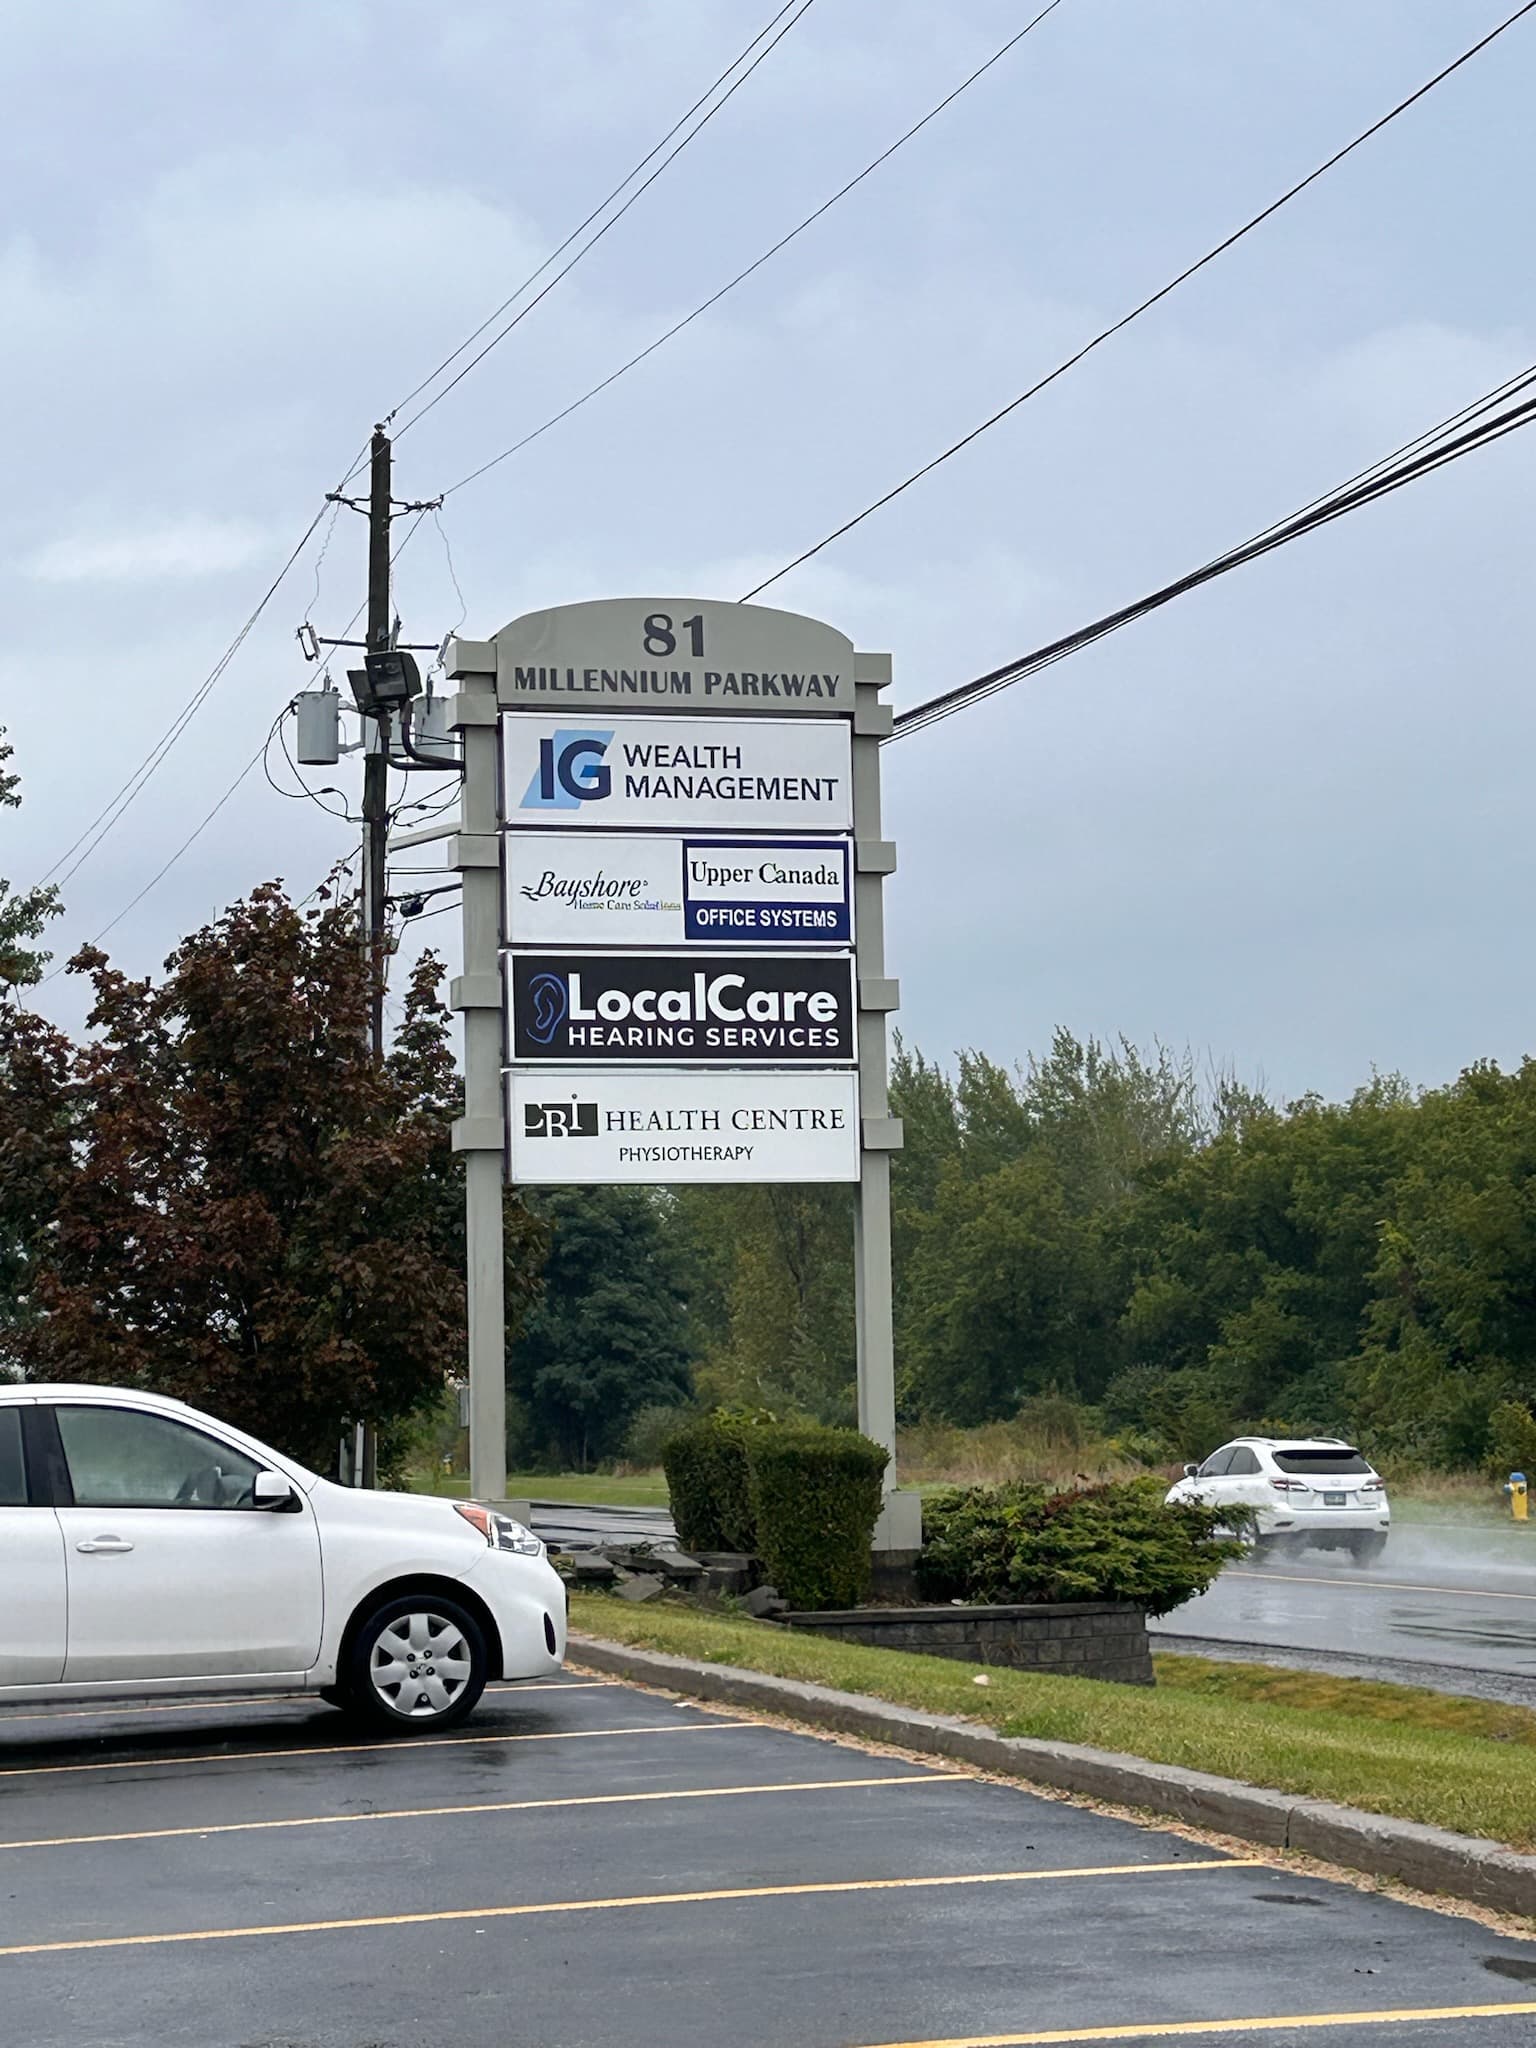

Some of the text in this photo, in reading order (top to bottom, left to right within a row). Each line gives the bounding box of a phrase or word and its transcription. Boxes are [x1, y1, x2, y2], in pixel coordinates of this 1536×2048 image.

[643, 613, 705, 658] 81
[514, 667, 840, 698] MILLENNIUM PARKWAY
[539, 738, 612, 801] IG
[623, 744, 742, 770] WEALTH
[625, 776, 839, 801] MANAGEMENT
[690, 861, 840, 887] Upper Canada
[696, 908, 838, 928] OFFICE SYSTEMS
[567, 972, 839, 1023] LocalCare
[568, 1027, 840, 1047] HEARING SERVICES
[605, 1109, 846, 1132] HEALTH CENTRE
[619, 1146, 755, 1161] PHYSIOTHERAPY
